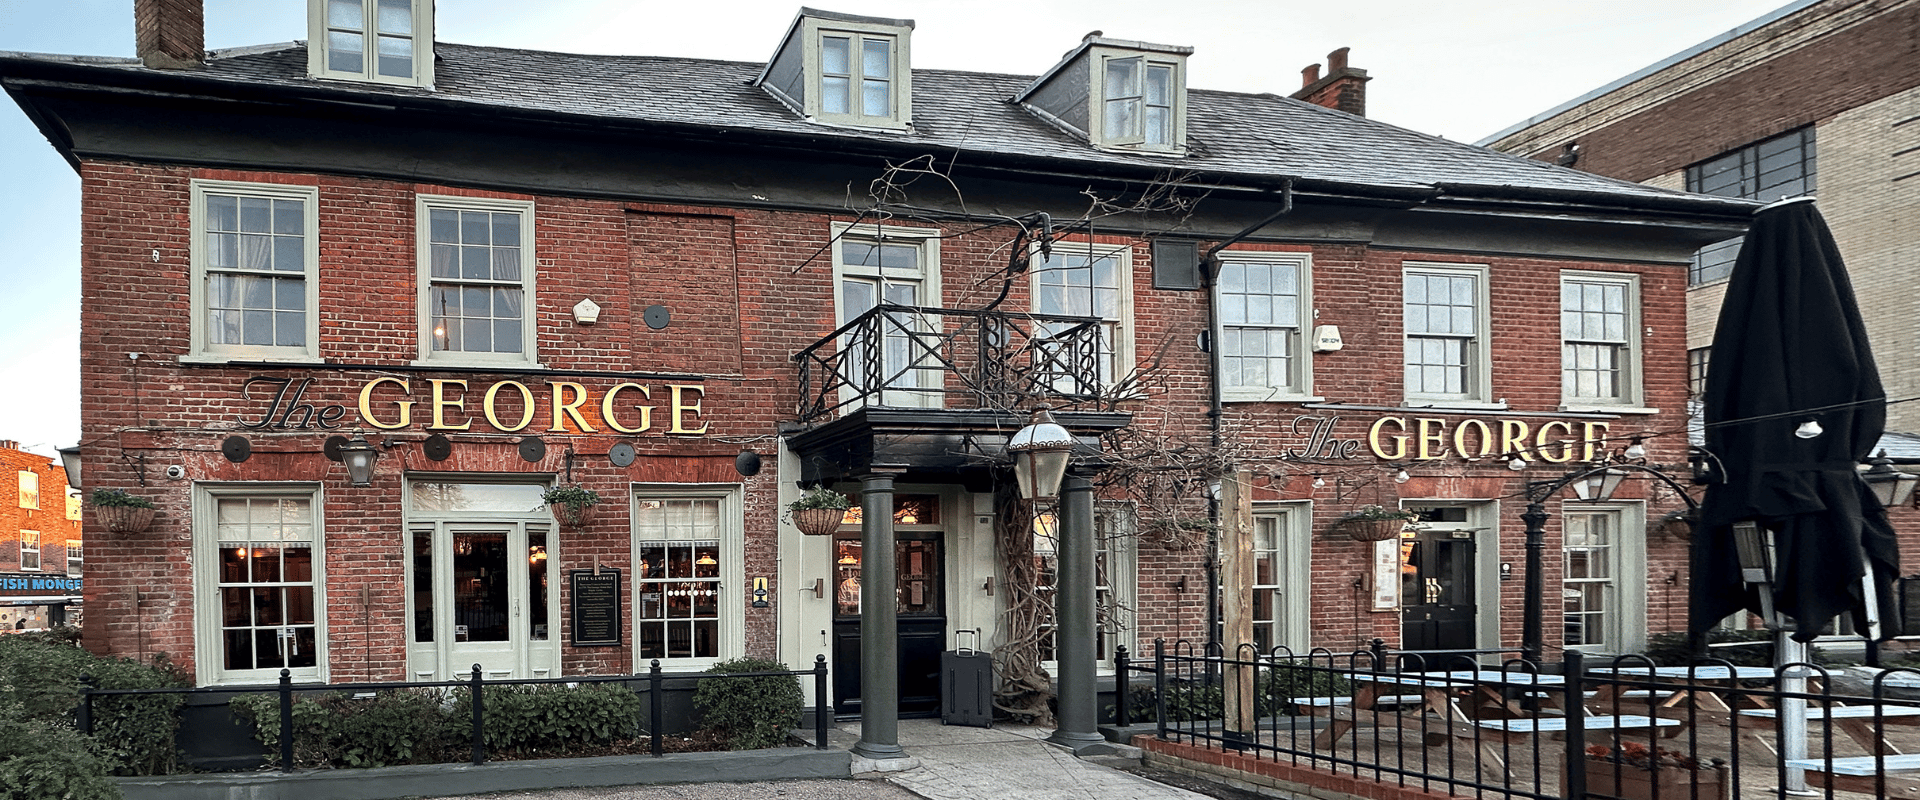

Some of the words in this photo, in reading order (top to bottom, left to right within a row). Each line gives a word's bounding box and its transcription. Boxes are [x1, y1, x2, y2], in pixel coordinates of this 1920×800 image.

[237, 376, 346, 430] The
[358, 376, 710, 435] GEORGE
[1288, 415, 1361, 460] The
[1368, 416, 1613, 463] GEORGE
[32, 578, 83, 590] MONGE
